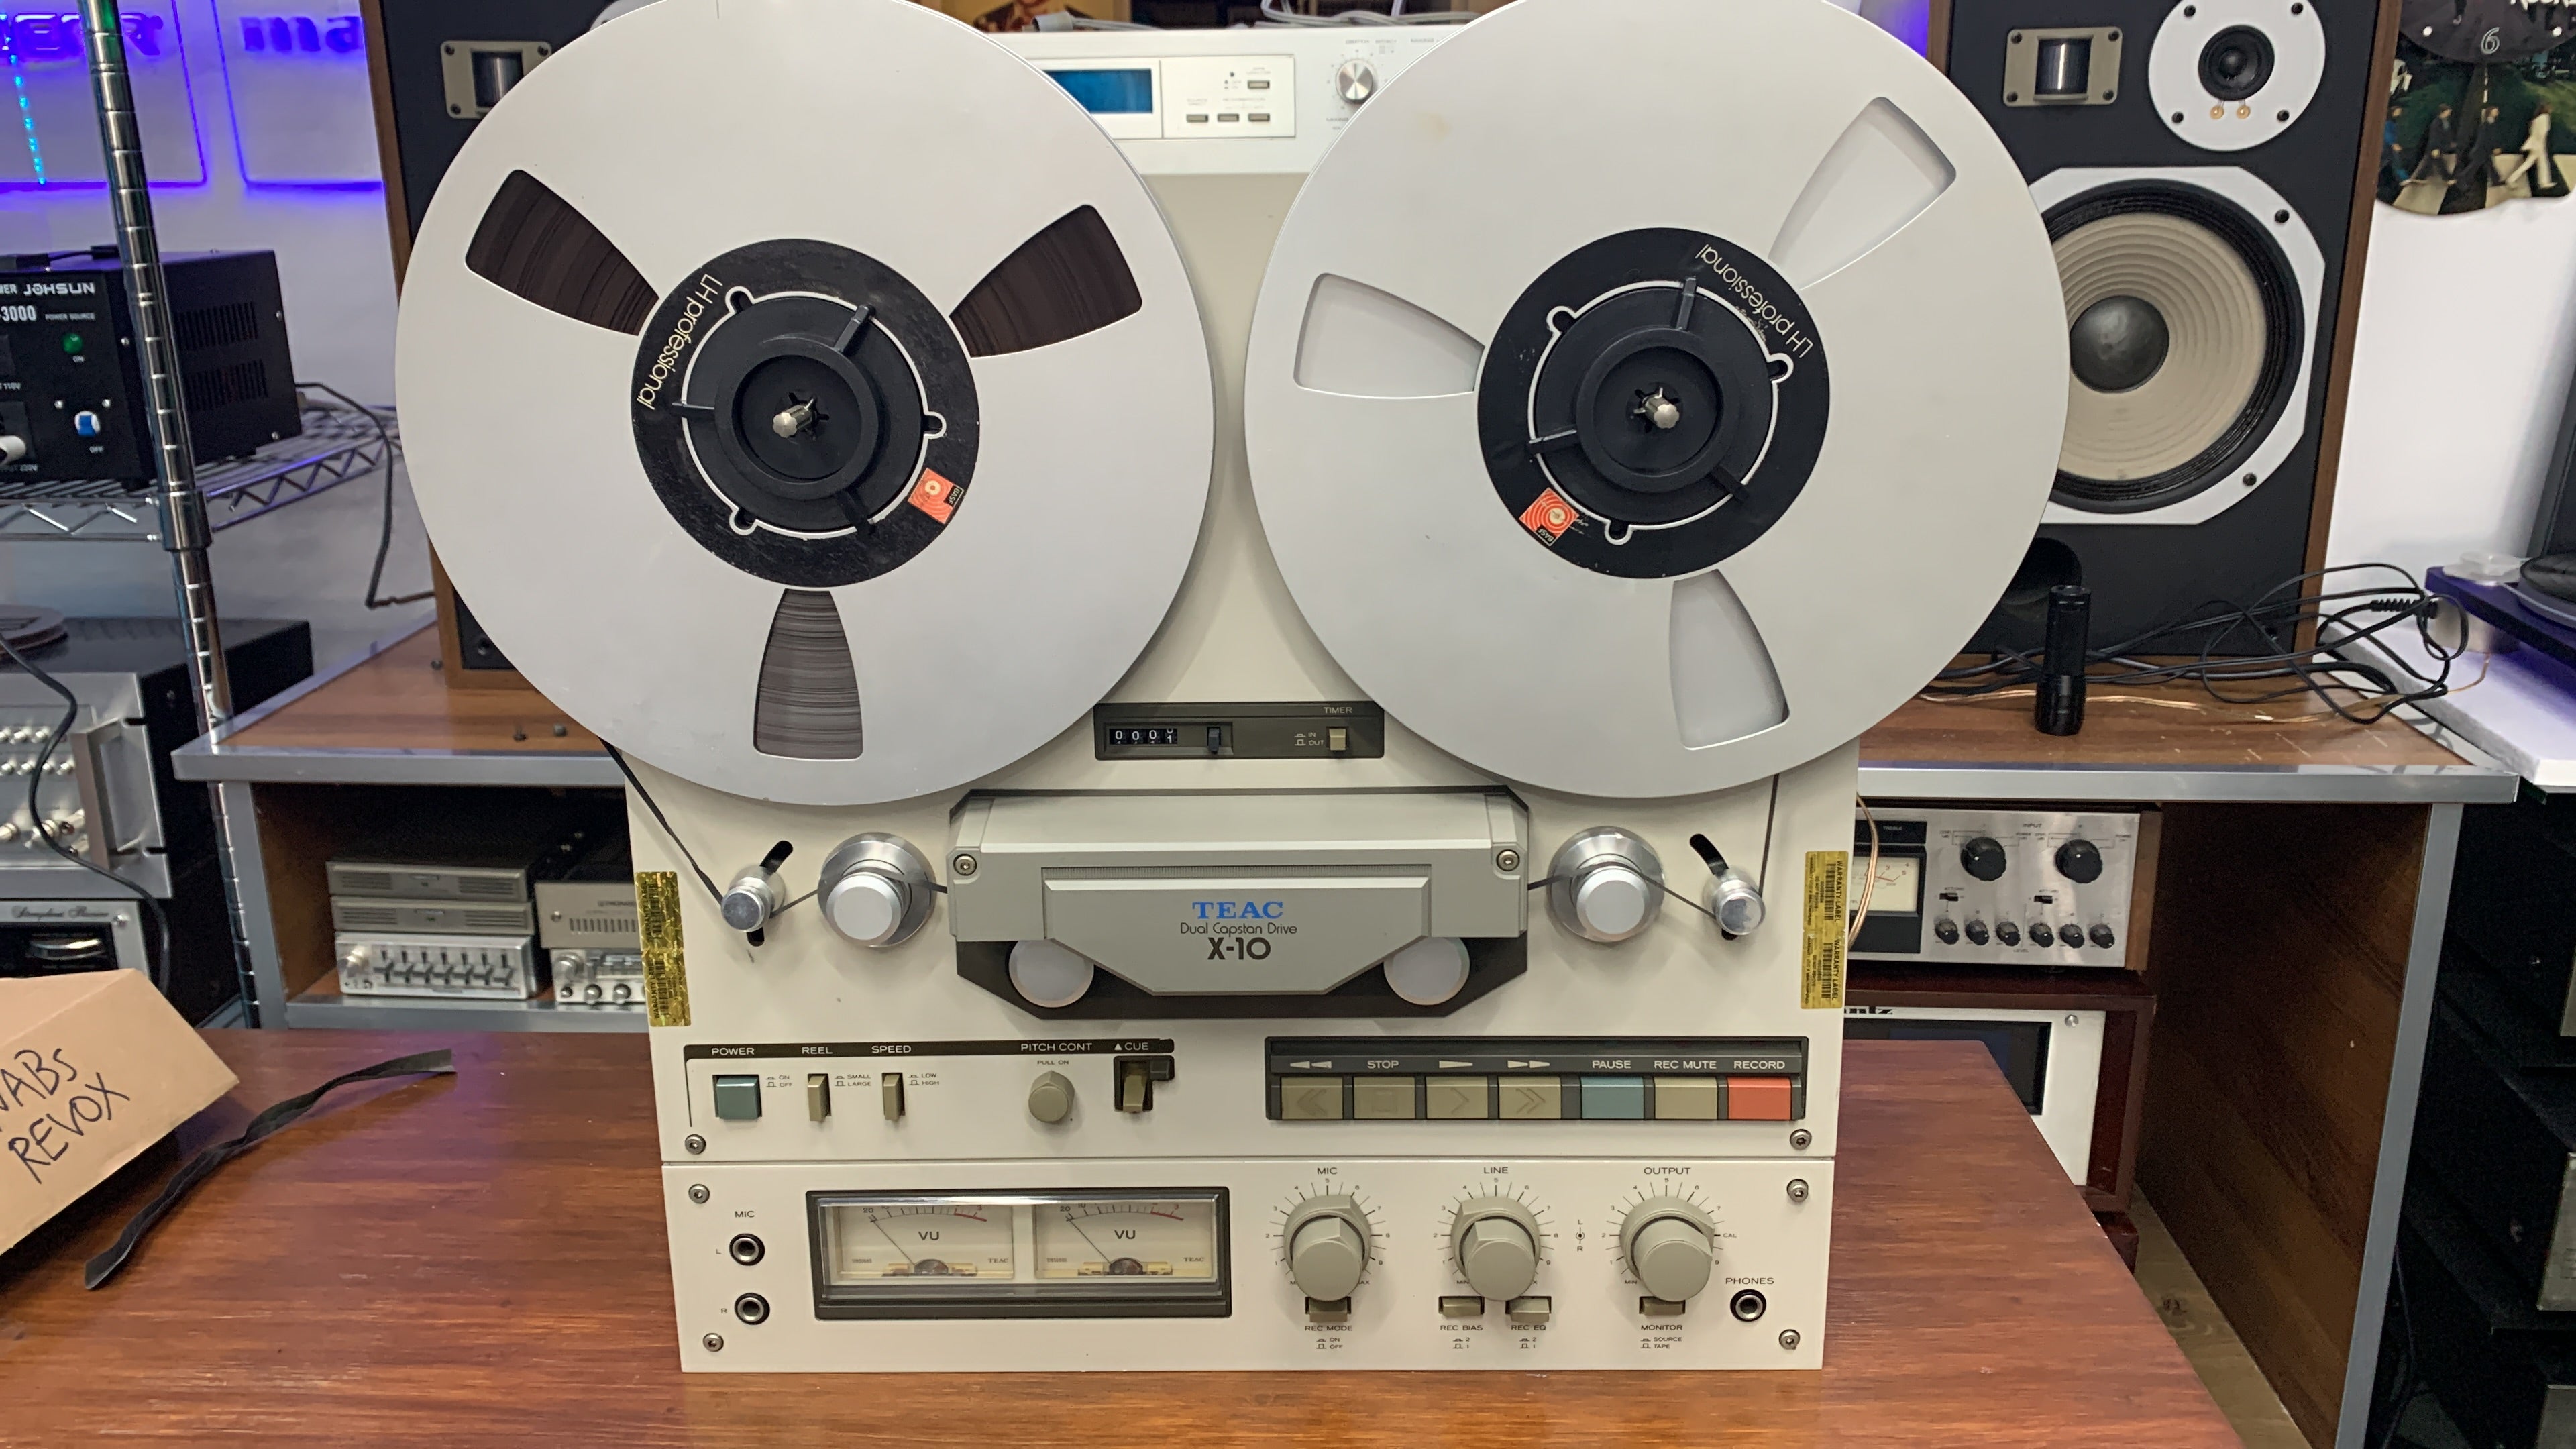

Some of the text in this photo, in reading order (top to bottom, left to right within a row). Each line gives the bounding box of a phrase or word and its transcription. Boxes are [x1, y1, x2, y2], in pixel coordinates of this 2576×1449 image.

[2481, 27, 2500, 54] 6
[23, 282, 95, 296] JOHSUN
[1695, 244, 1813, 358] LH professional
[637, 274, 723, 410] LH professional
[948, 487, 961, 505] BASF
[1323, 706, 1352, 714] TIMER
[1192, 901, 1283, 919] TEAC
[1180, 922, 1298, 938] Dual Capstan Drive
[1208, 937, 1271, 960] X-10
[1844, 1006, 1893, 1014] ntz
[711, 1046, 755, 1056] POWER
[802, 1046, 833, 1055] REEL
[871, 1045, 912, 1054] SPEED
[1020, 1042, 1092, 1052] PITCH CONT
[1124, 1042, 1149, 1051] CUE
[1367, 1060, 1399, 1069] STOP
[1592, 1059, 1631, 1069] PAUSE
[1654, 1059, 1717, 1069] REC MUTE
[1733, 1059, 1785, 1069] RECORD
[8, 1072, 130, 1185] REVOX
[918, 1231, 940, 1241] VU
[1114, 1230, 1136, 1240] VU
